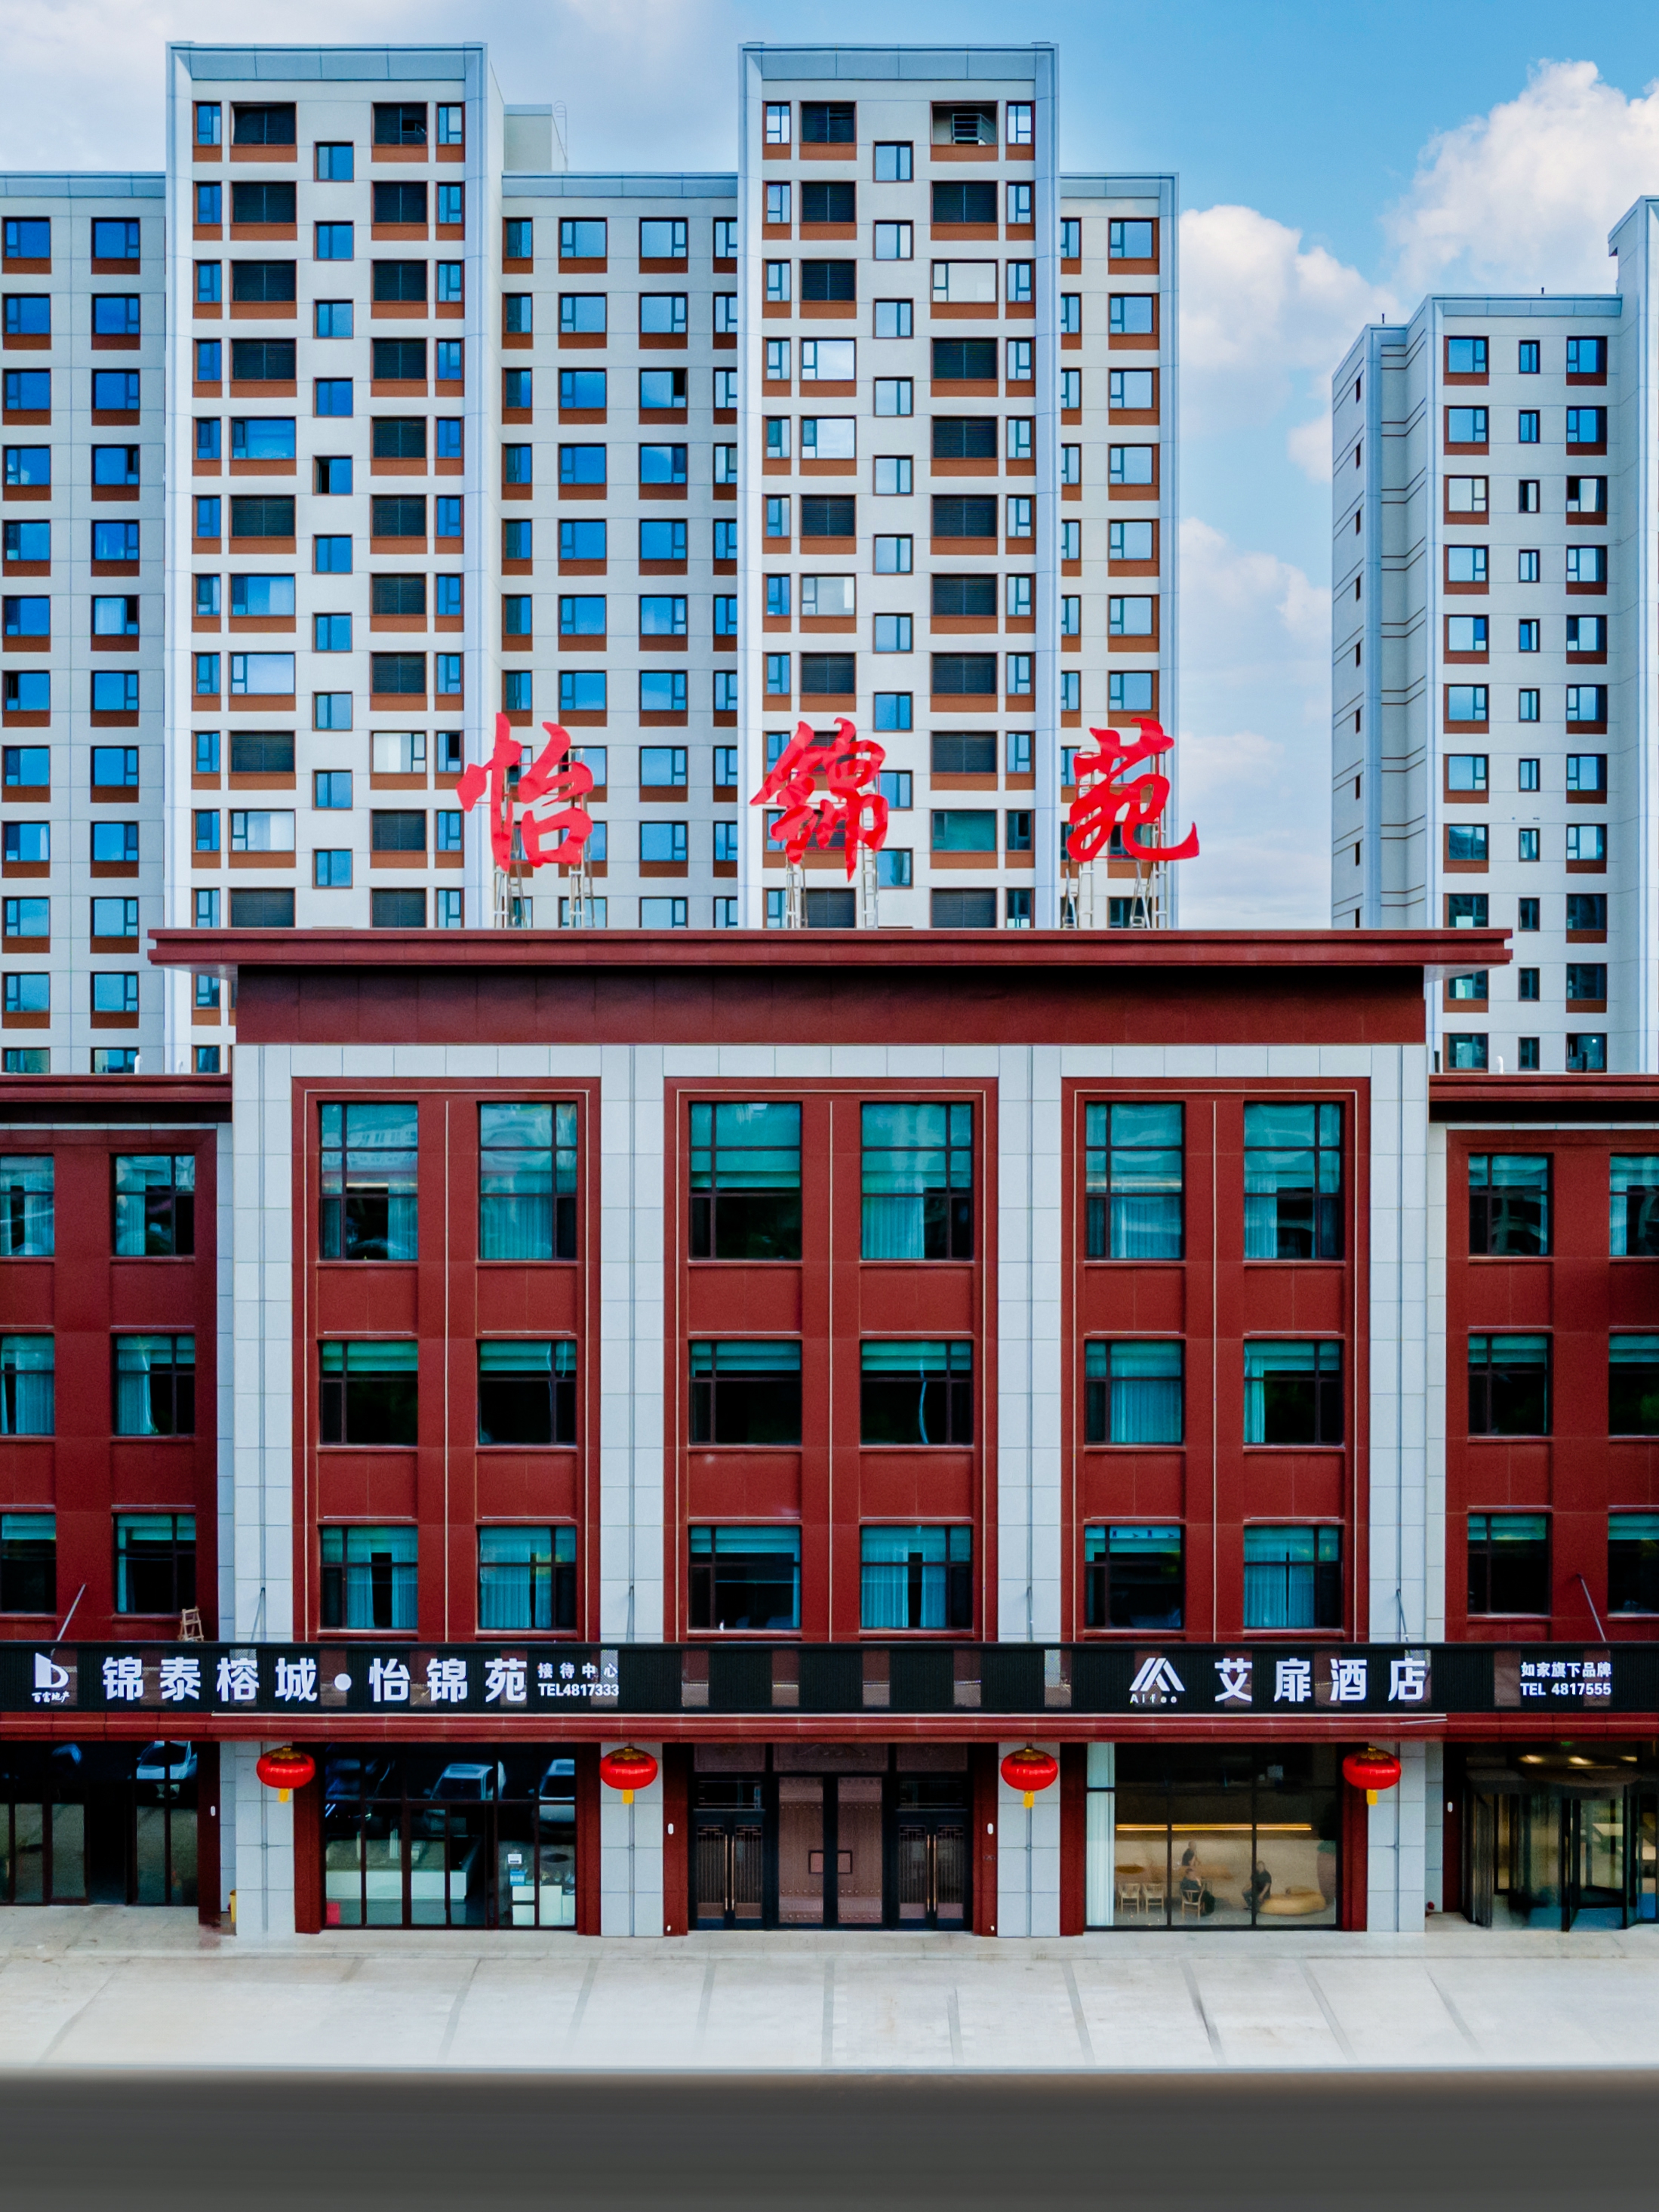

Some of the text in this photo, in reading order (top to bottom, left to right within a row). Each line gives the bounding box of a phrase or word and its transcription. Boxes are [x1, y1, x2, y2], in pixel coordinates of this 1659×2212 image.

[537, 1662, 618, 1679] 接待中心
[1521, 1662, 1612, 1678] 如家旗下品牌
[1214, 1658, 1426, 1702] 艾扉酒店
[537, 1683, 620, 1696] TEL4817333
[1520, 1683, 1612, 1696] TEL 4817555
